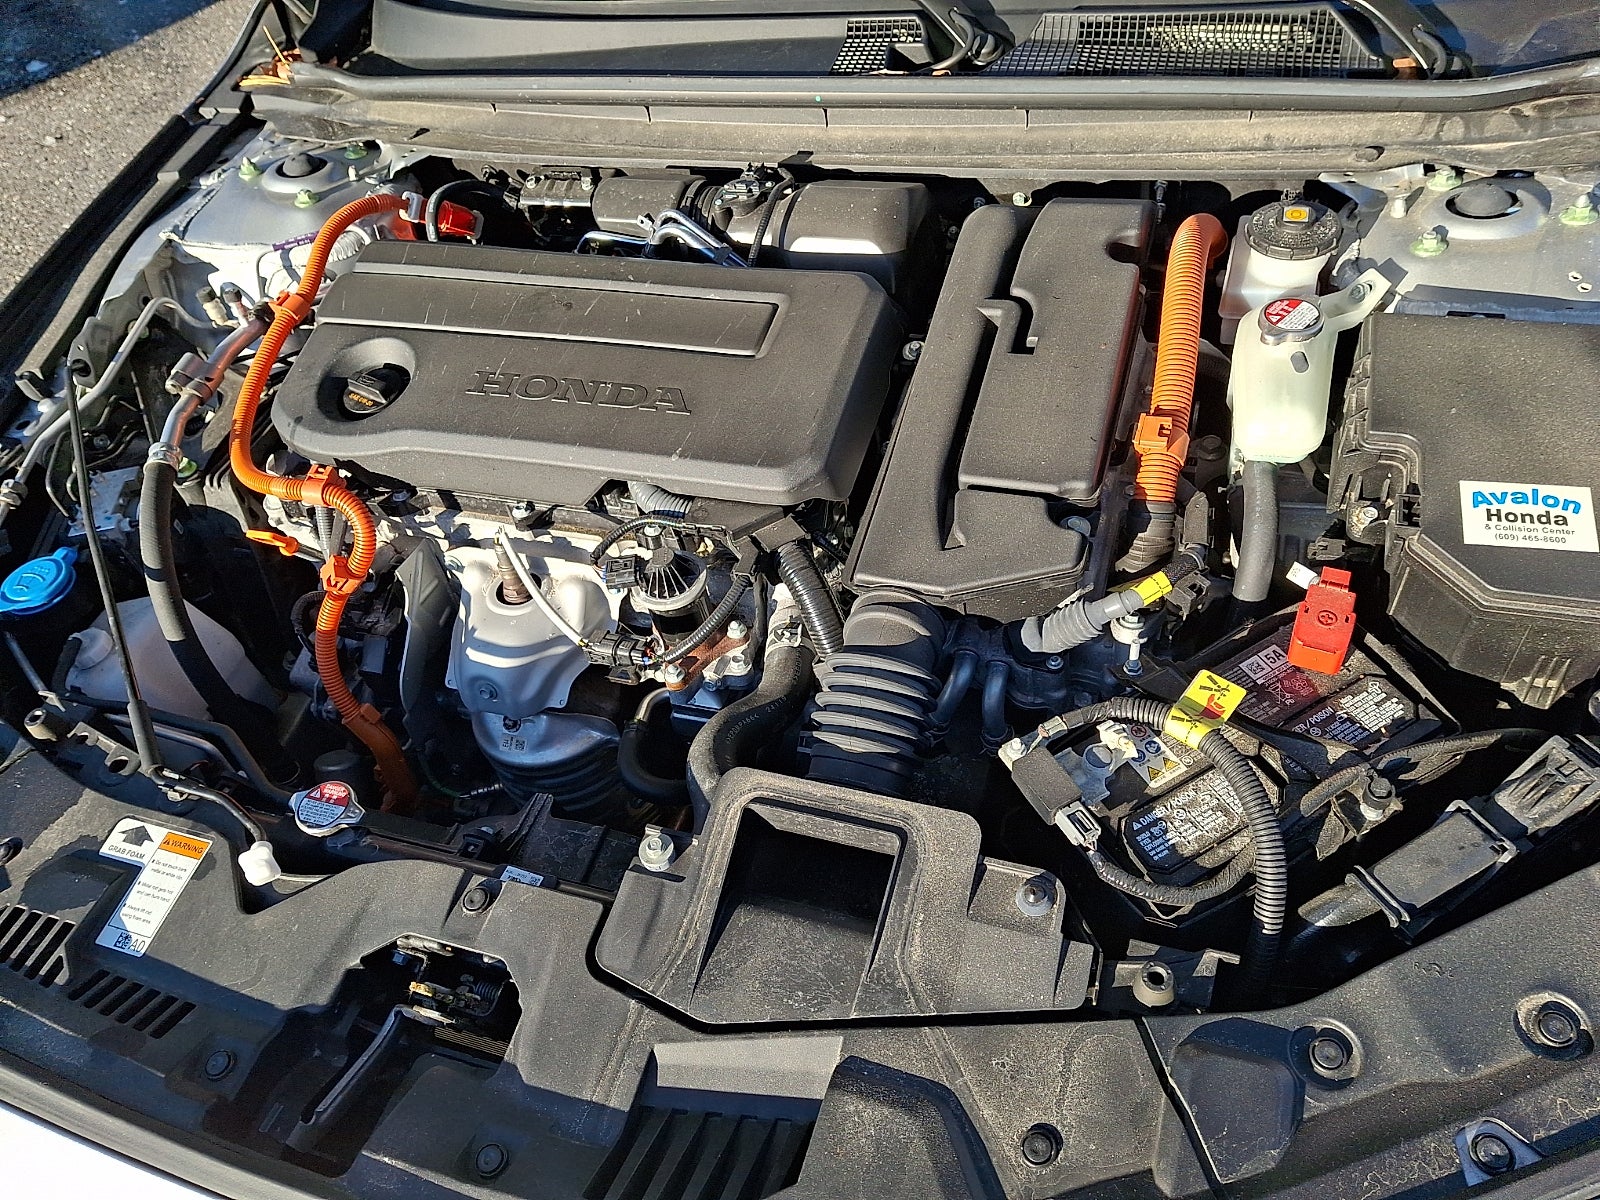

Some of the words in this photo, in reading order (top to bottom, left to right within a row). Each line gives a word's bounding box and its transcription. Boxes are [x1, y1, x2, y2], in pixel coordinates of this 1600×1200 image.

[466, 371, 692, 416] HONDA
[1472, 489, 1582, 514] Avalon
[1486, 509, 1568, 525] Honda
[1495, 524, 1538, 532] Collision
[1542, 527, 1575, 535] Center
[1264, 650, 1286, 664] 5A
[108, 845, 127, 856] GRAB
[125, 850, 145, 859] FOAM
[171, 840, 203, 853] WARNING
